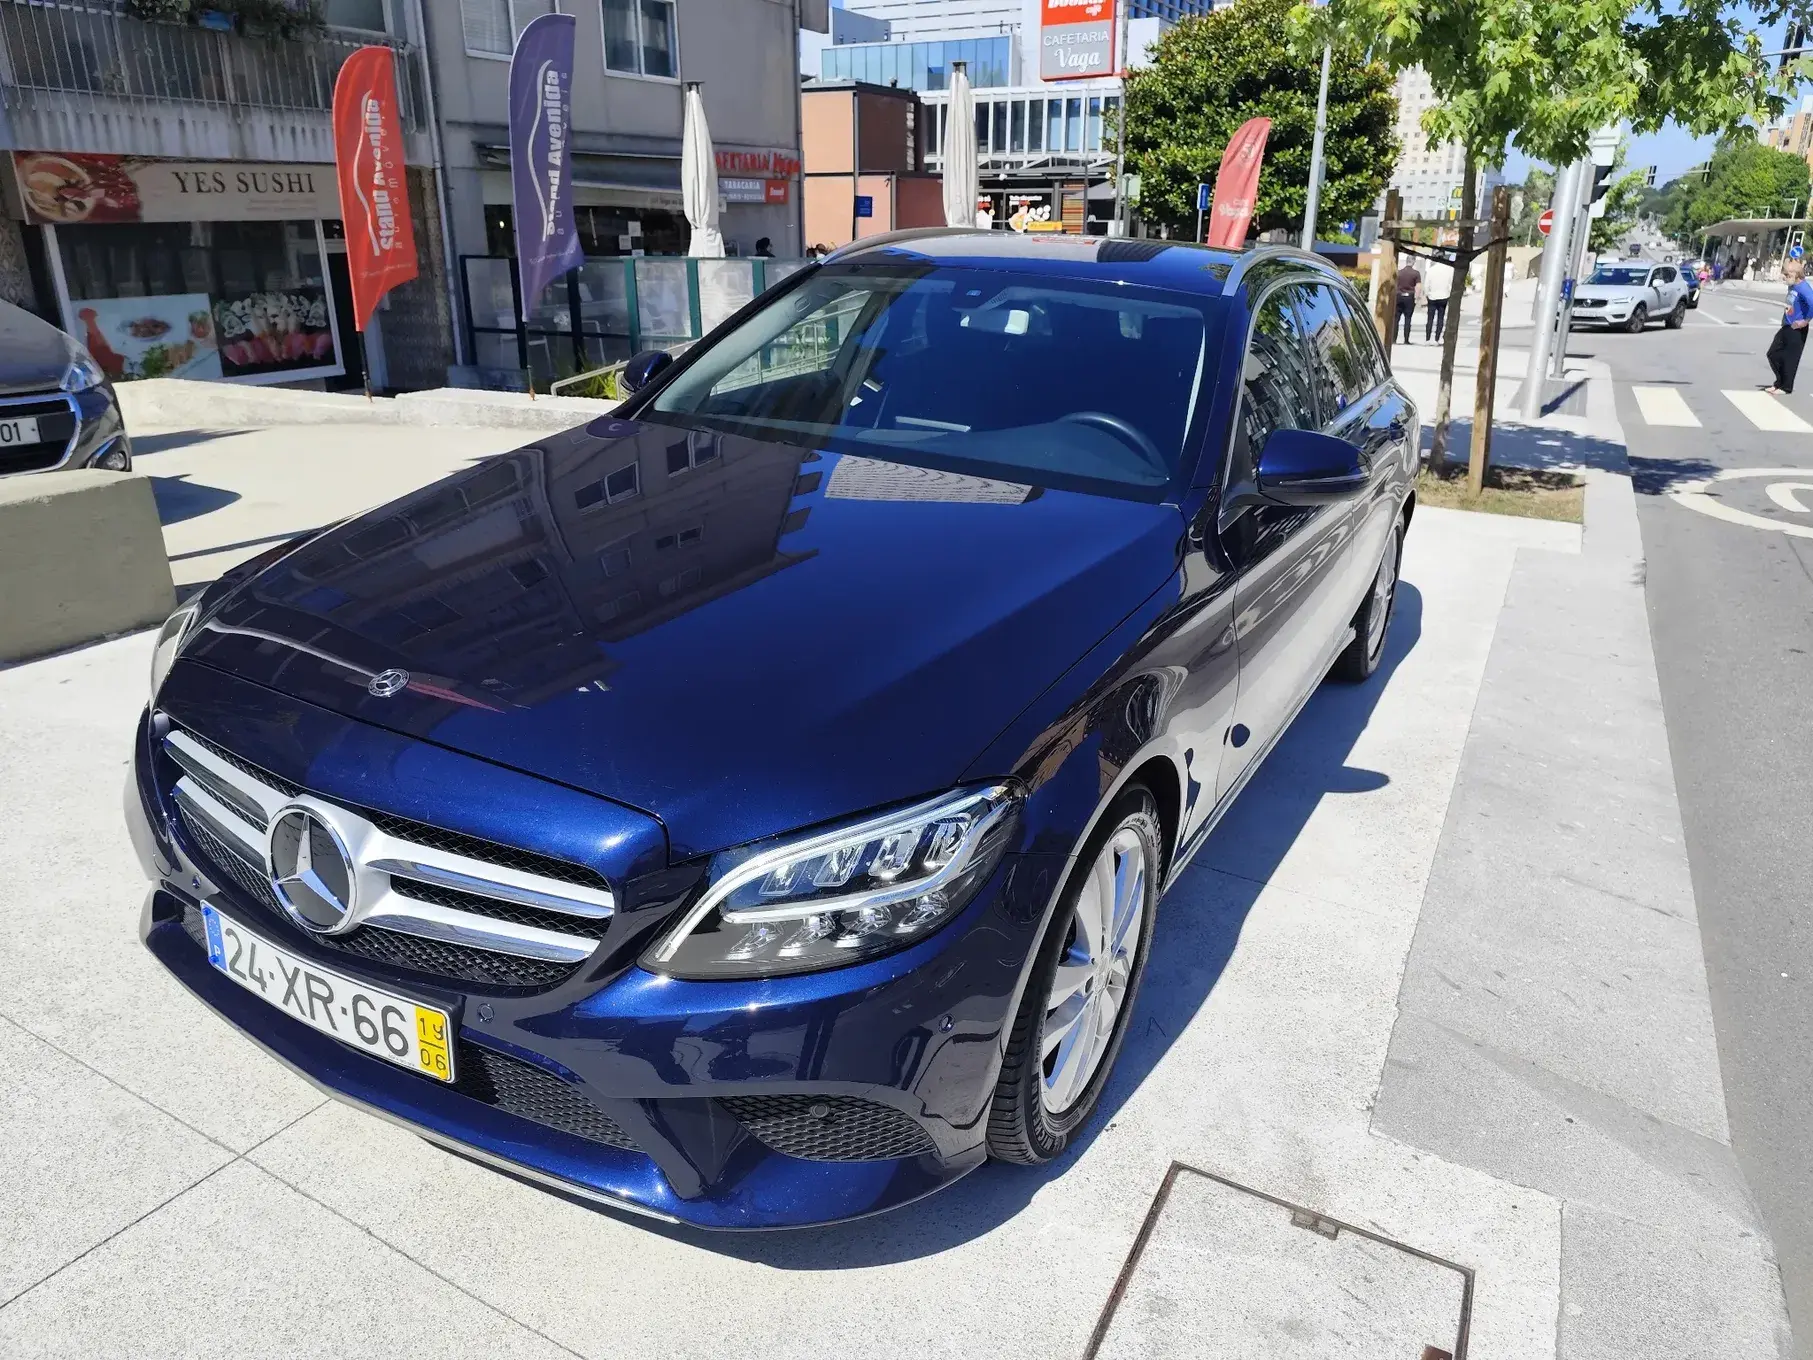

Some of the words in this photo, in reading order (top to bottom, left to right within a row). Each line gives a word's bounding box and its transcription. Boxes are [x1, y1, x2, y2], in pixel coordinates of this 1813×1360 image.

[1043, 31, 1110, 47] CAFETARIA
[1054, 48, 1101, 73] Vaga
[544, 70, 562, 166] Avenida
[364, 98, 386, 186] Avenida
[172, 171, 226, 193] YES
[236, 172, 316, 193] SUSHI
[372, 189, 395, 250] Stand
[420, 1017, 444, 1041] 19
[420, 1047, 447, 1071] 06
[1031, 1080, 1054, 1151] MICHELIN
